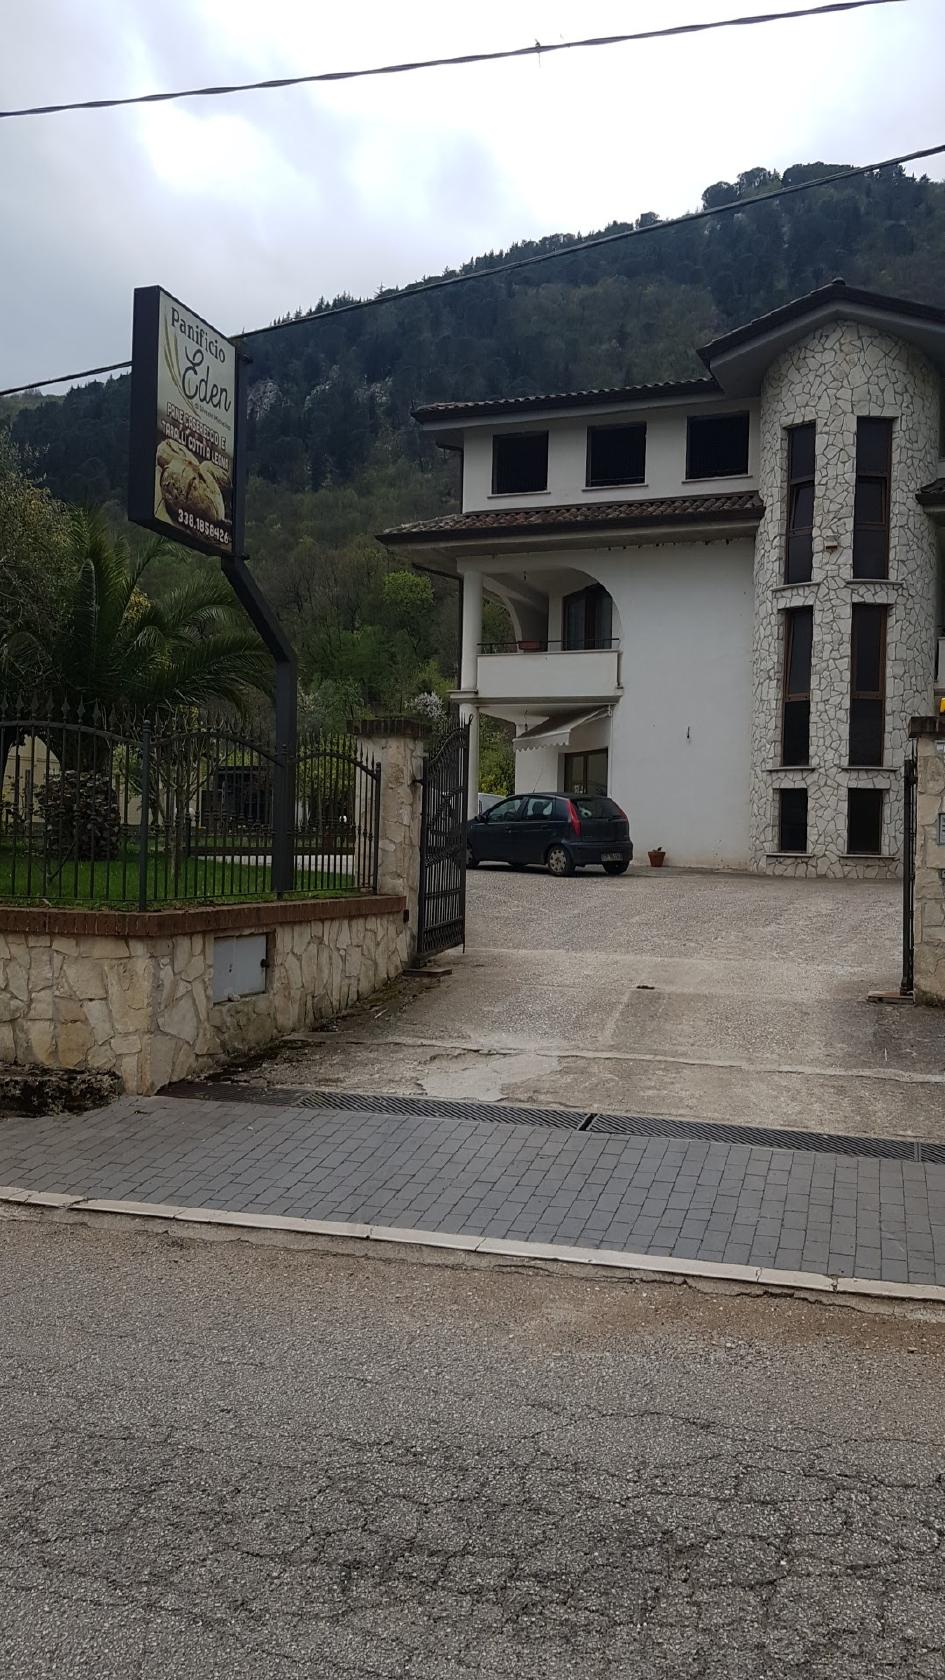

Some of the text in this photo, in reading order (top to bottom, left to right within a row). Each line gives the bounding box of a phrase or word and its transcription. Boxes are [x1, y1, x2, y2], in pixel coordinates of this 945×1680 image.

[171, 307, 226, 364] Panificio
[182, 345, 232, 412] Eden
[167, 402, 185, 424] PANE
[188, 436, 206, 458] COTTI
